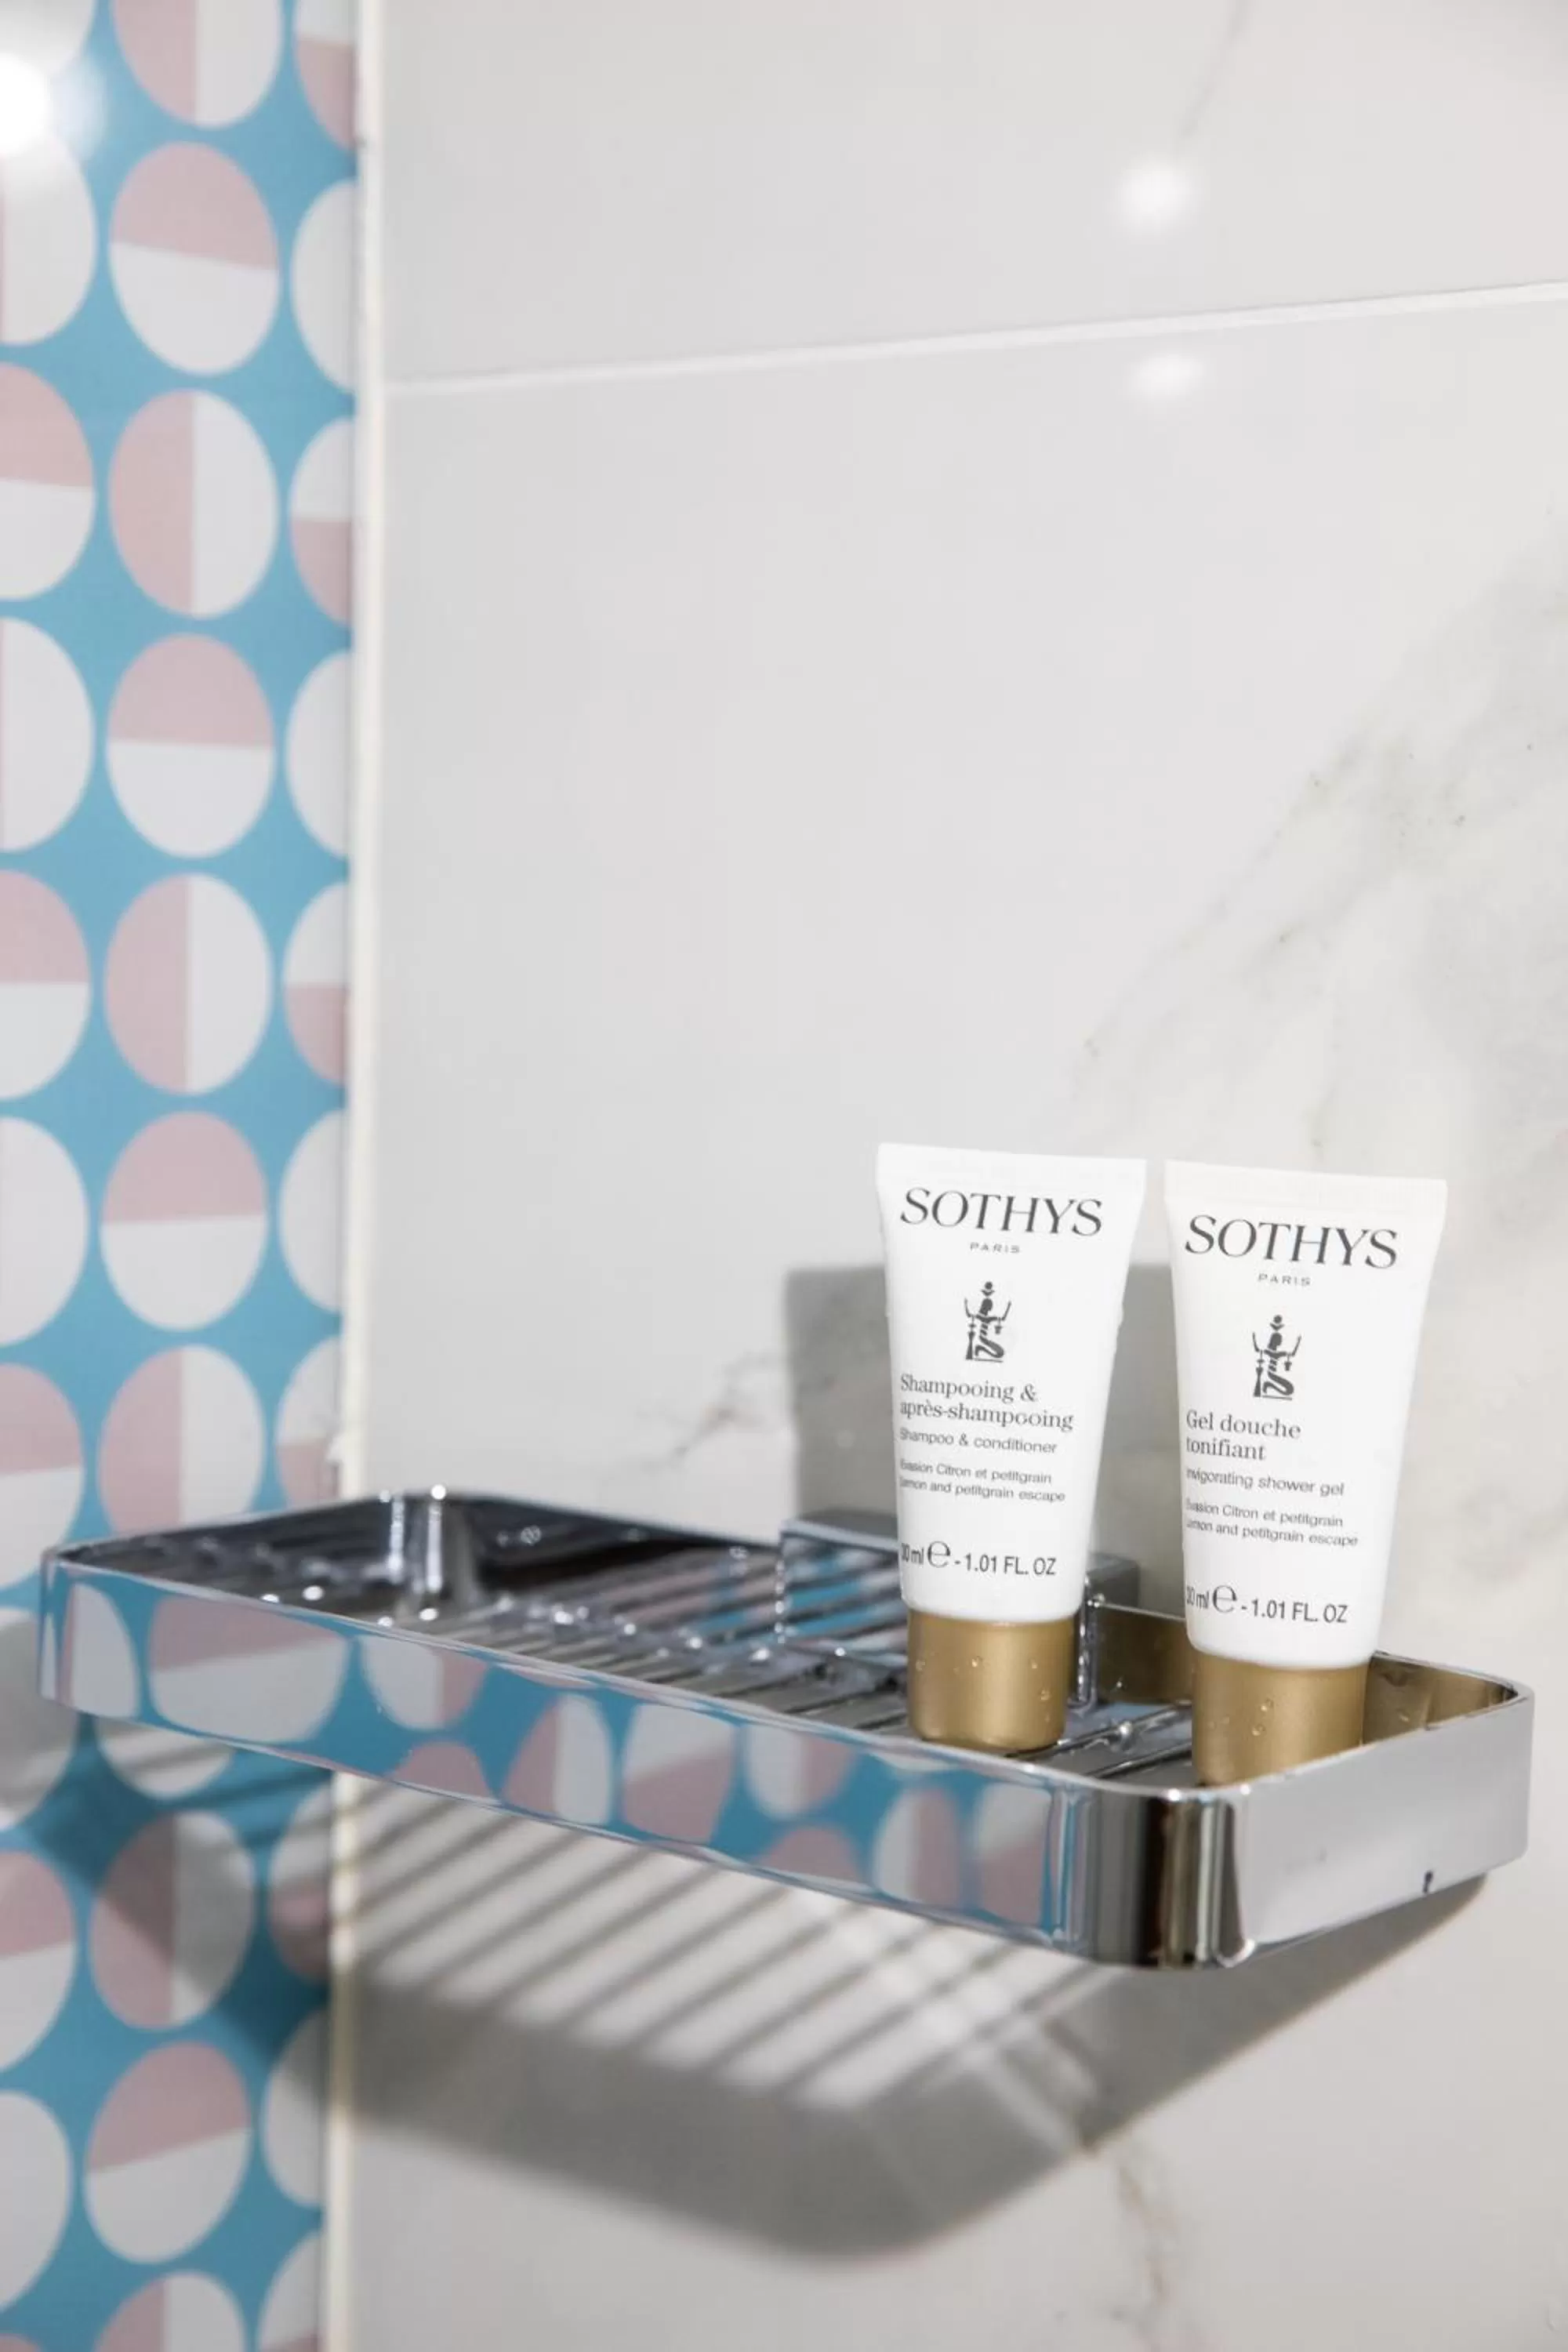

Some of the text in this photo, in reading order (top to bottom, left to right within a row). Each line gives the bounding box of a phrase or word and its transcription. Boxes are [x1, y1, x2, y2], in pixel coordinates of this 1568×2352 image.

[900, 1187, 1103, 1237] SOTHYS
[970, 1241, 1021, 1254] PARIS
[1185, 1214, 1398, 1269] SOTHYS
[1258, 1272, 1312, 1287] PARIS
[900, 1373, 1037, 1403] Shampooing &
[900, 1399, 1074, 1431] après-shampooing
[1186, 1410, 1302, 1439] Gel douche
[899, 1426, 1058, 1454] Shampoo & conditioner
[1186, 1436, 1266, 1461] tonifiant
[936, 1462, 972, 1478] Citron
[975, 1468, 988, 1481] et
[991, 1469, 1052, 1486] petitgrain
[1186, 1466, 1345, 1498] nvigorating shower gel
[930, 1481, 952, 1494] and
[954, 1482, 1014, 1501] petitgrain
[1018, 1490, 1066, 1503] escape
[1222, 1503, 1259, 1519] Citron
[1262, 1508, 1276, 1522] et
[1279, 1512, 1344, 1529] petitgrain
[1215, 1523, 1239, 1537] and
[1242, 1525, 1305, 1544] petitgrain
[1308, 1533, 1359, 1548] escape
[964, 1552, 998, 1574] 1.01
[1003, 1555, 1029, 1576] FL.
[1033, 1557, 1058, 1576] OZ
[1251, 1597, 1287, 1620] 1.01
[1291, 1601, 1318, 1622] FL.
[1323, 1603, 1349, 1624] OZ
